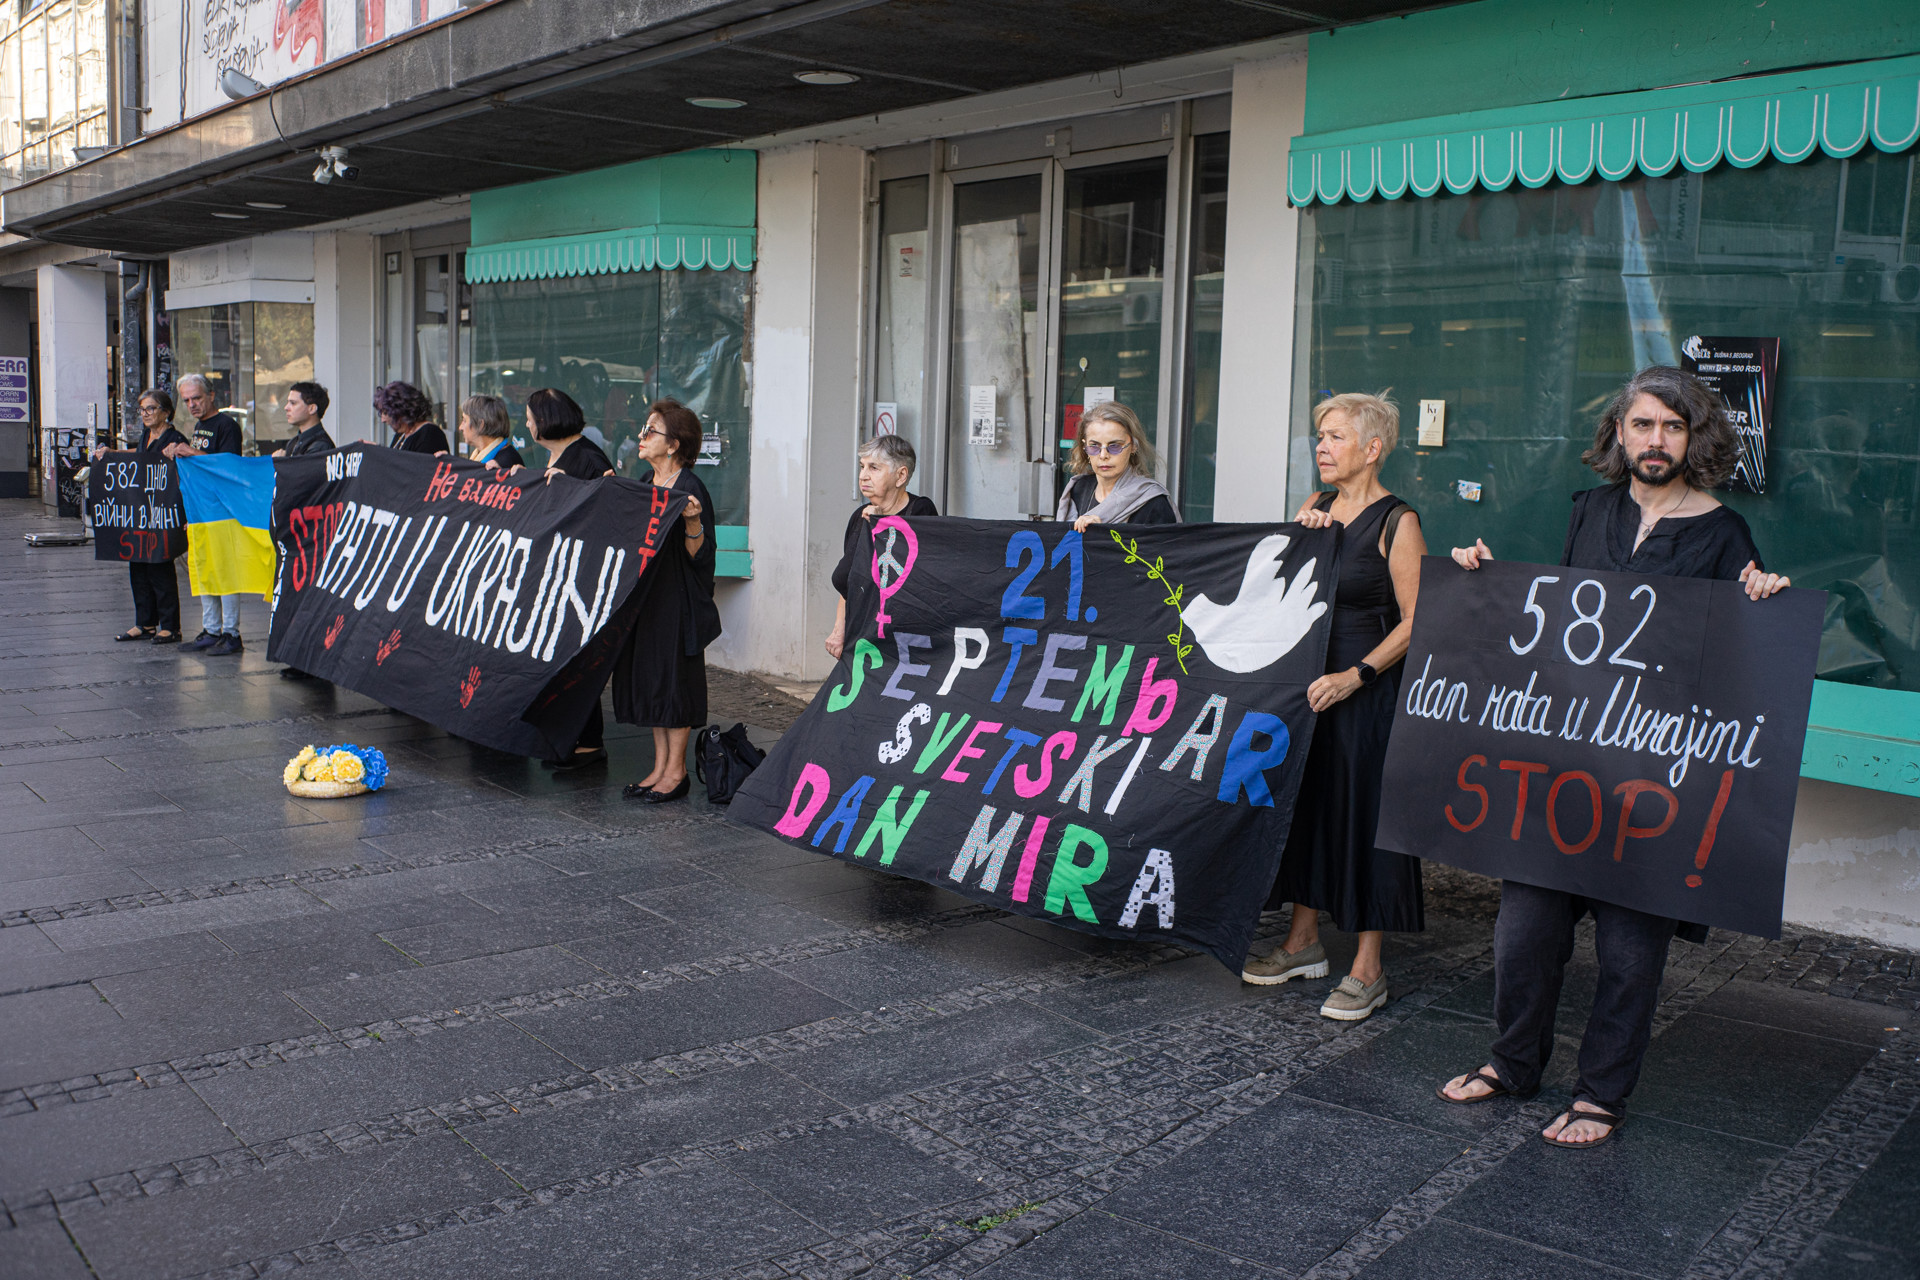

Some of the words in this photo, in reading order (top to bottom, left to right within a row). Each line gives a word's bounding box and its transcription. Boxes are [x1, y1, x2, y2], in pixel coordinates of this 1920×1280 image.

[1731, 365, 1745, 373] 500
[1745, 365, 1762, 373] RSD
[104, 461, 139, 491] 582
[326, 452, 345, 482] NO
[424, 461, 459, 502] Не
[316, 501, 413, 611] RATU
[386, 515, 449, 613] U
[424, 521, 626, 663] UKRAJINI
[1000, 529, 1099, 623] 21.
[1509, 575, 1663, 672] 582.
[878, 702, 1153, 817] SVETSKI
[1406, 653, 1470, 723] dan
[1478, 670, 1553, 737] rata
[1558, 696, 1590, 741] u
[1589, 675, 1765, 787] Ukrajini
[773, 762, 931, 867] DAN
[949, 804, 1176, 930] MIRA
[1444, 752, 1735, 888] STOP!
